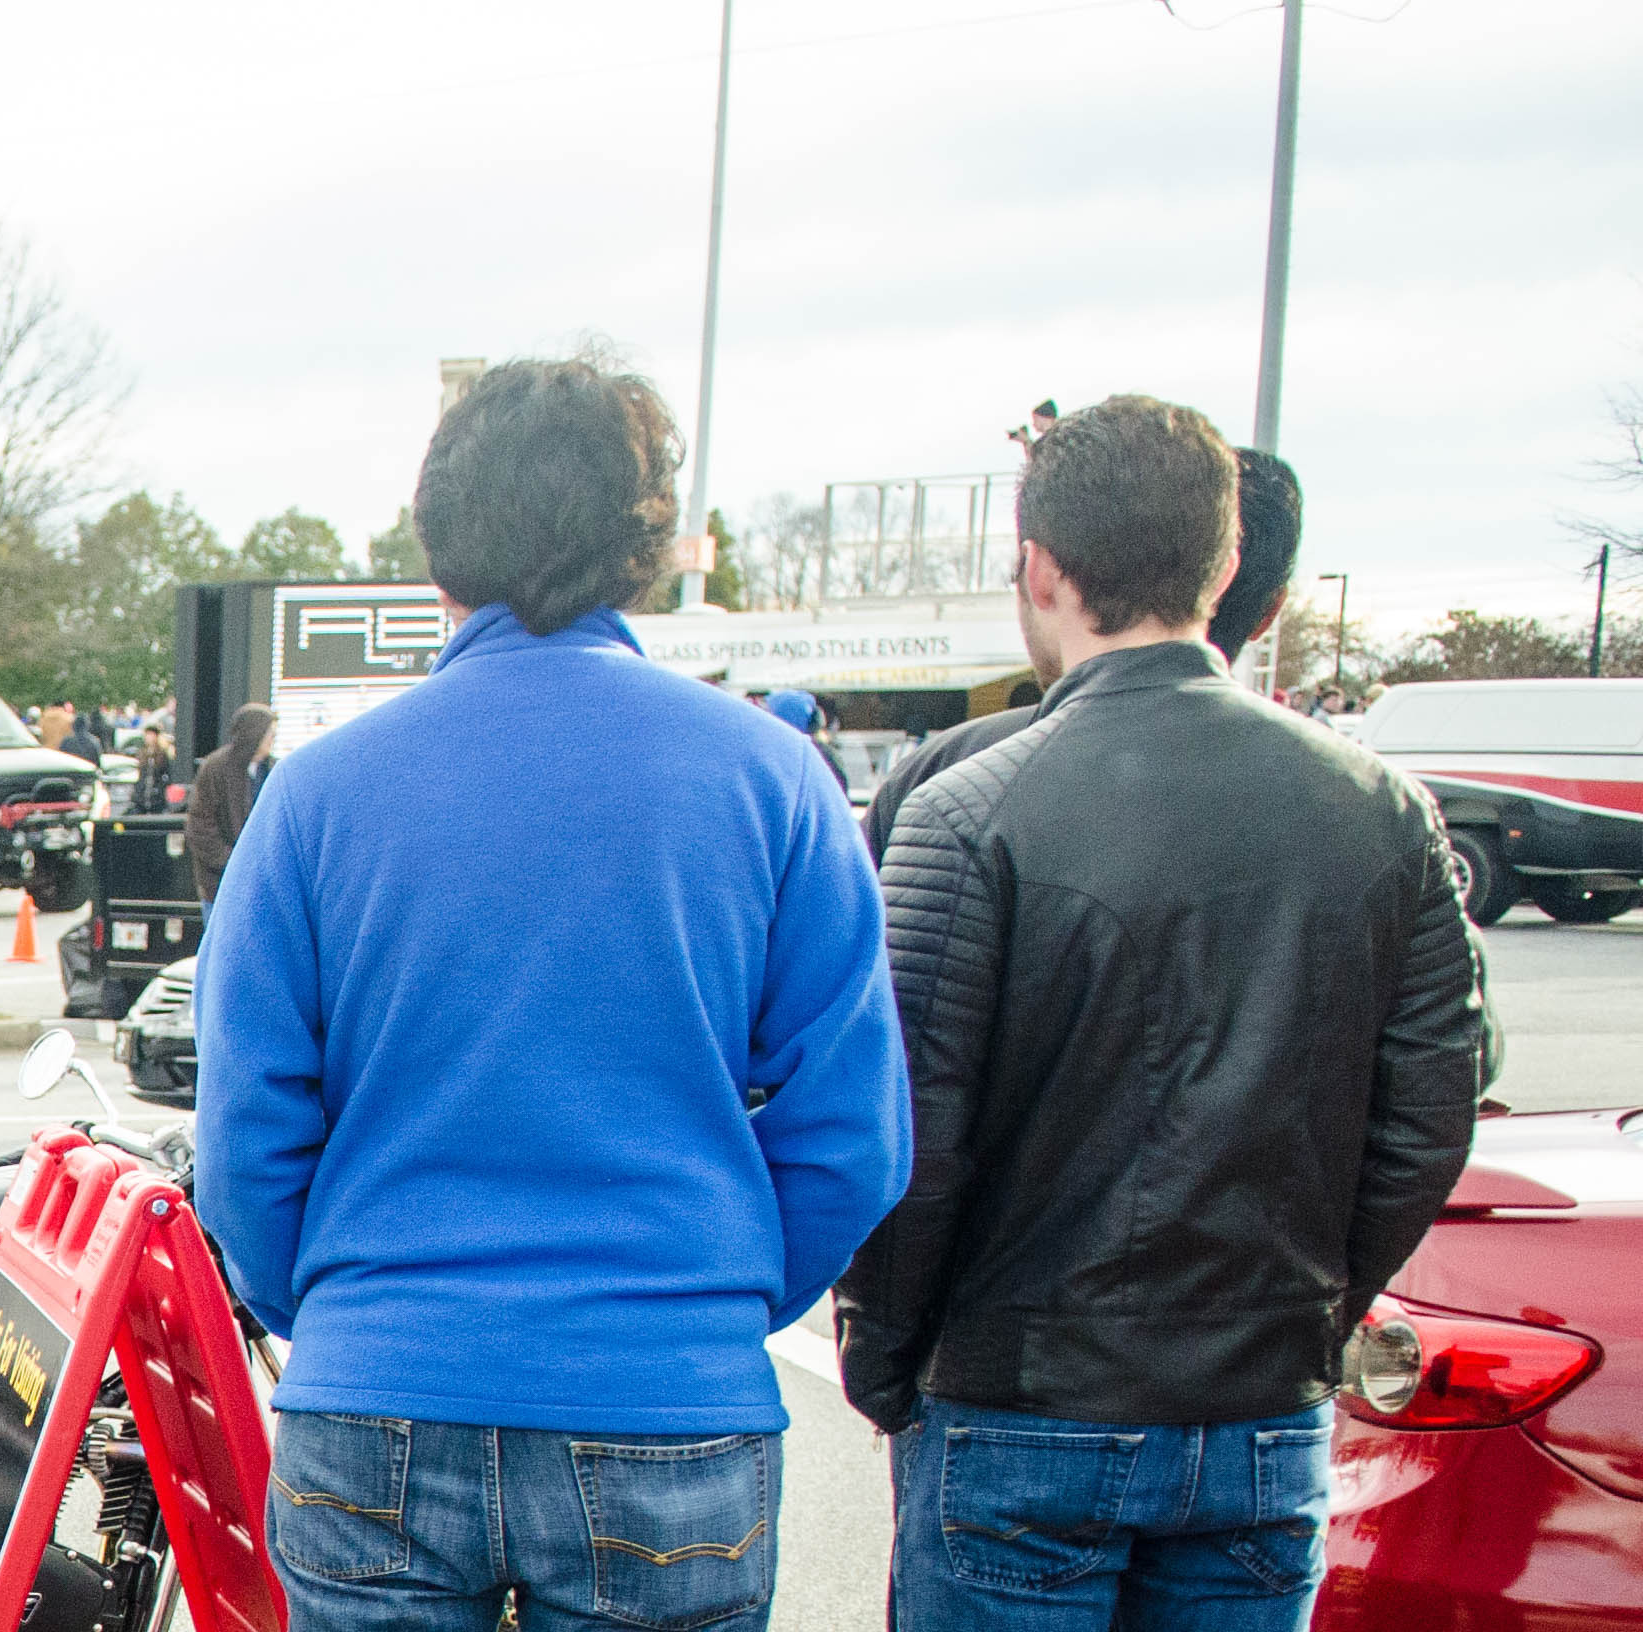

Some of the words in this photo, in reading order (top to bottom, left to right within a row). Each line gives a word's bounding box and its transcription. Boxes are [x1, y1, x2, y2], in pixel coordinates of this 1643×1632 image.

[708, 641, 764, 660] SPEED
[771, 639, 811, 658] AND
[817, 638, 870, 657] STYLE
[877, 636, 951, 655] EVENTS
[9, 1333, 48, 1428] Visiting
